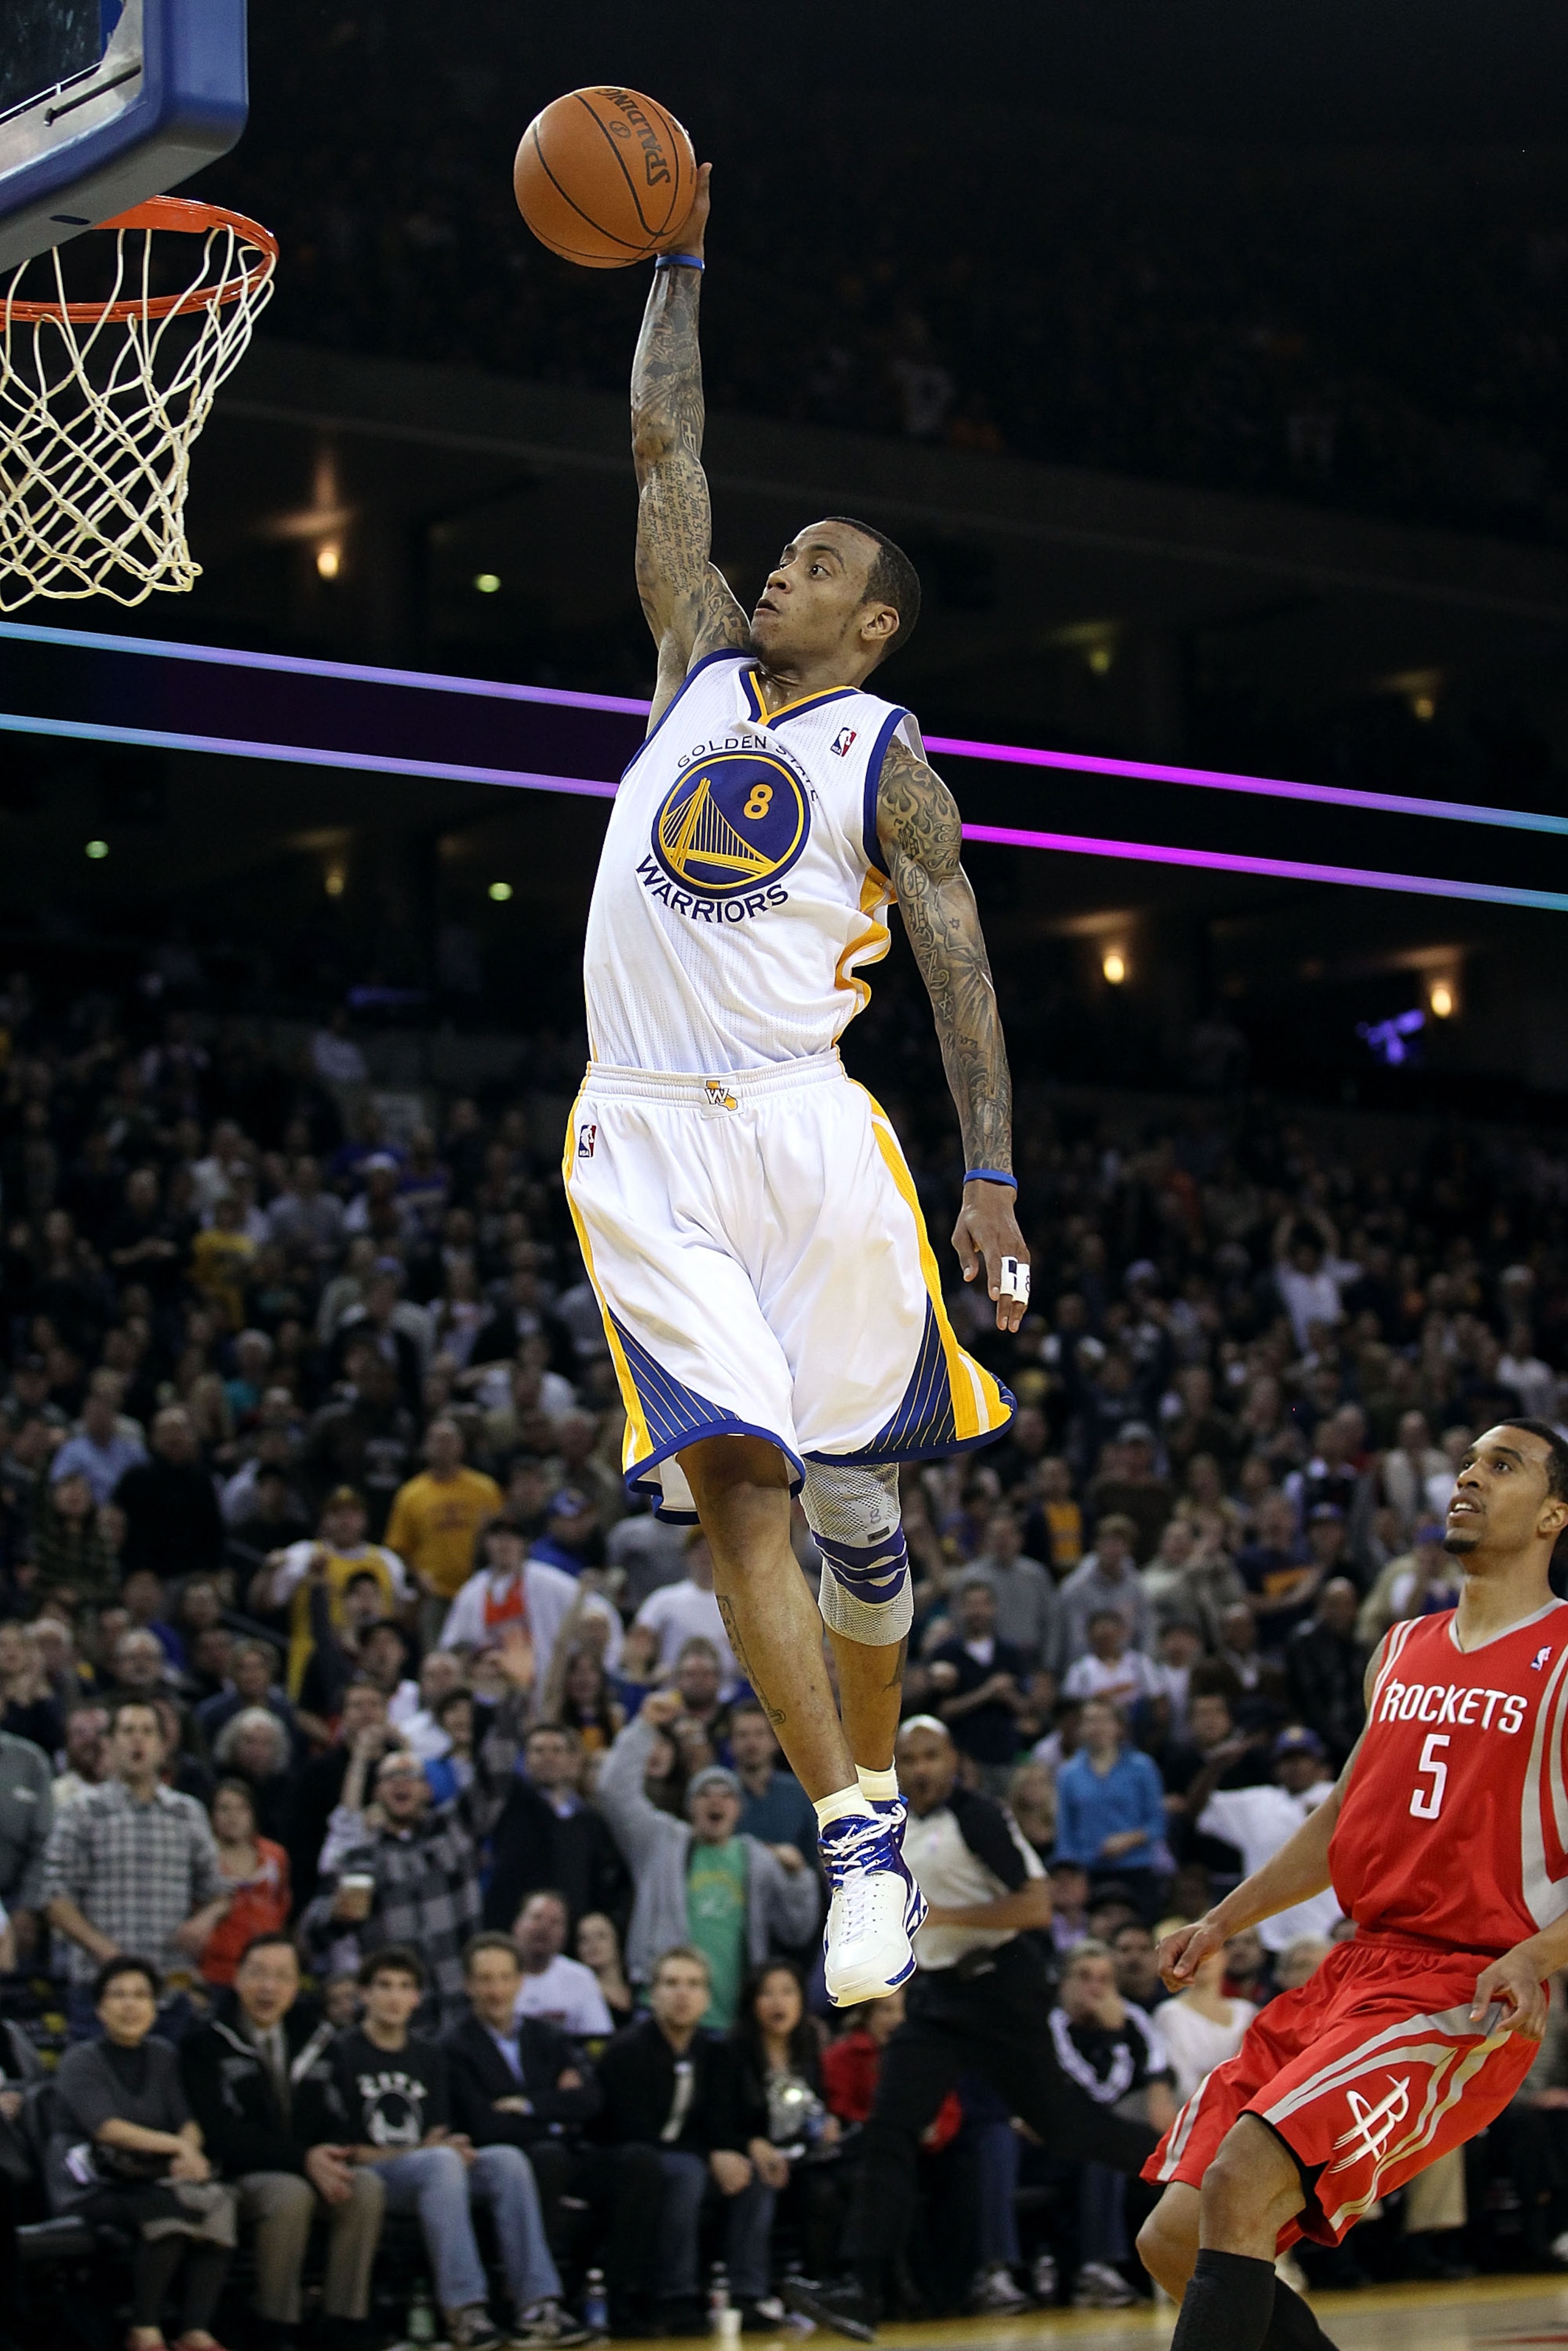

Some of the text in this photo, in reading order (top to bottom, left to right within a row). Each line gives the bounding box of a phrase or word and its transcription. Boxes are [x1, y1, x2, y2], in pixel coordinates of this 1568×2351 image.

[595, 89, 671, 186] SPALDING
[665, 461, 676, 483] that
[656, 483, 667, 505] that
[666, 484, 676, 494] he
[648, 502, 658, 517] not
[666, 496, 680, 515] gave
[688, 492, 703, 519] John
[649, 518, 663, 545] perish
[658, 506, 671, 542] whoever
[674, 459, 700, 583] For God so loved the world
[677, 551, 688, 573] and
[673, 586, 681, 596] in
[677, 734, 767, 768] GOLDEN
[744, 784, 773, 819] 8
[635, 853, 789, 923] WARRIORS
[706, 1087, 729, 1104] W
[1379, 1678, 1528, 1734] ROCKETS
[1409, 1733, 1451, 1820] 5
